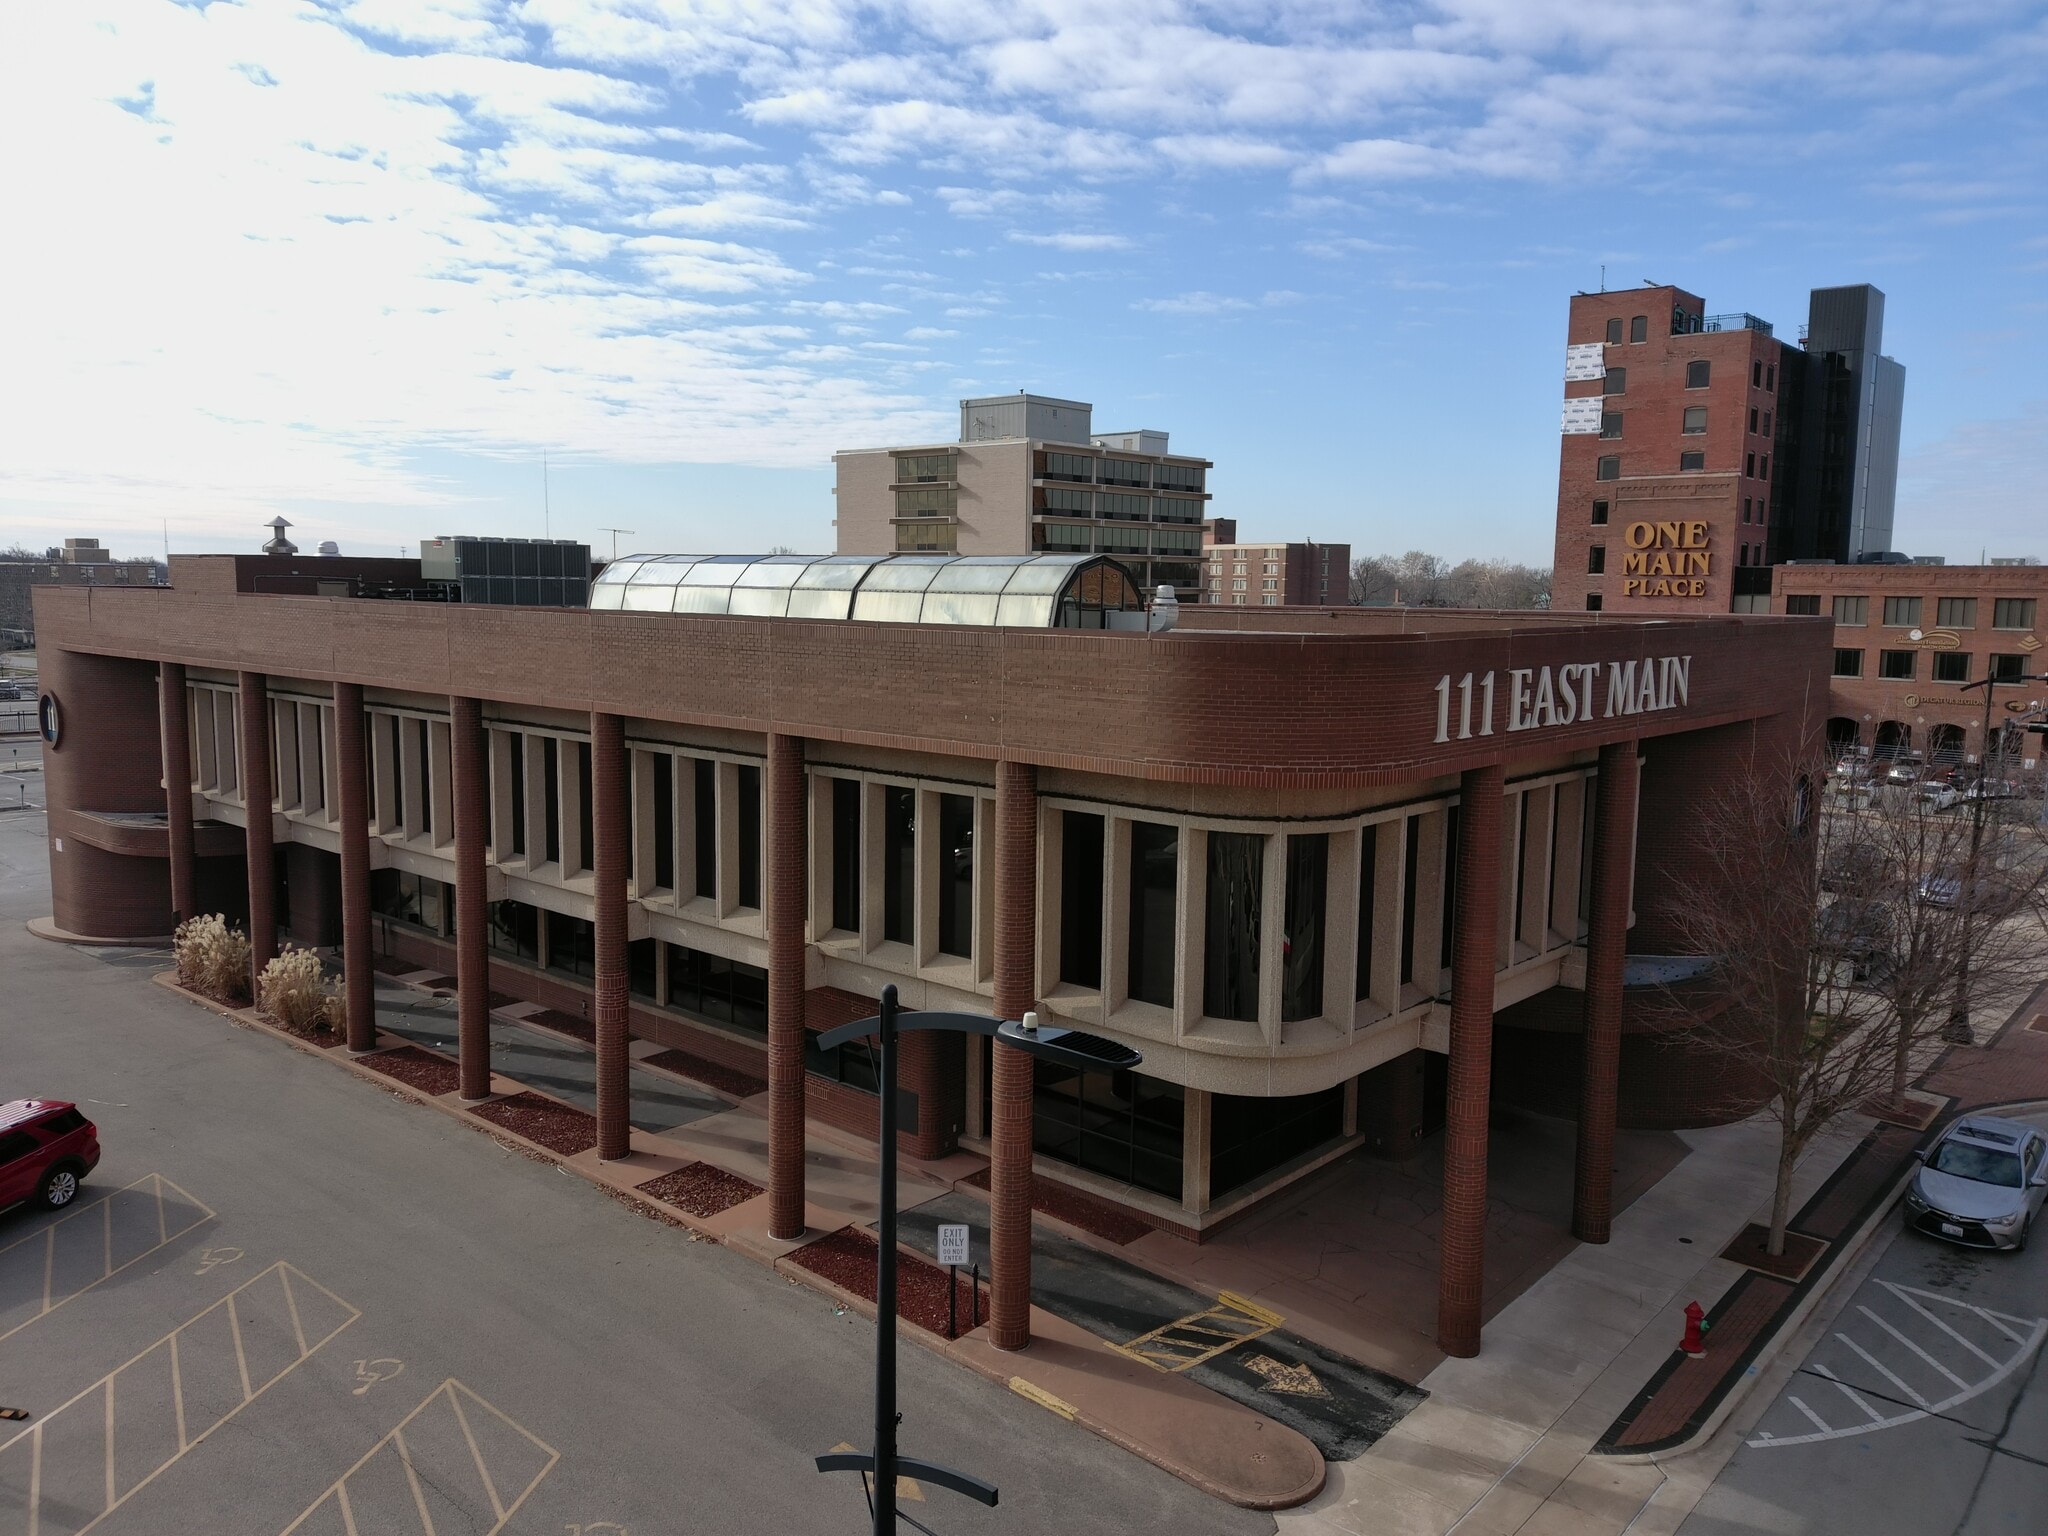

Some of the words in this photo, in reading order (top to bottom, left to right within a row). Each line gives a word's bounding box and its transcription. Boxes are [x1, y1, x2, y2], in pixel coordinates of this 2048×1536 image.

[1625, 521, 1710, 550] ONE
[1622, 552, 1712, 576] MAIN
[1623, 579, 1706, 597] PLACE
[1433, 671, 1494, 743] 111
[1506, 662, 1600, 732] EAST
[1603, 655, 1692, 718] MAIN
[942, 1238, 964, 1247] ONLY
[944, 1228, 962, 1237] EXIT
